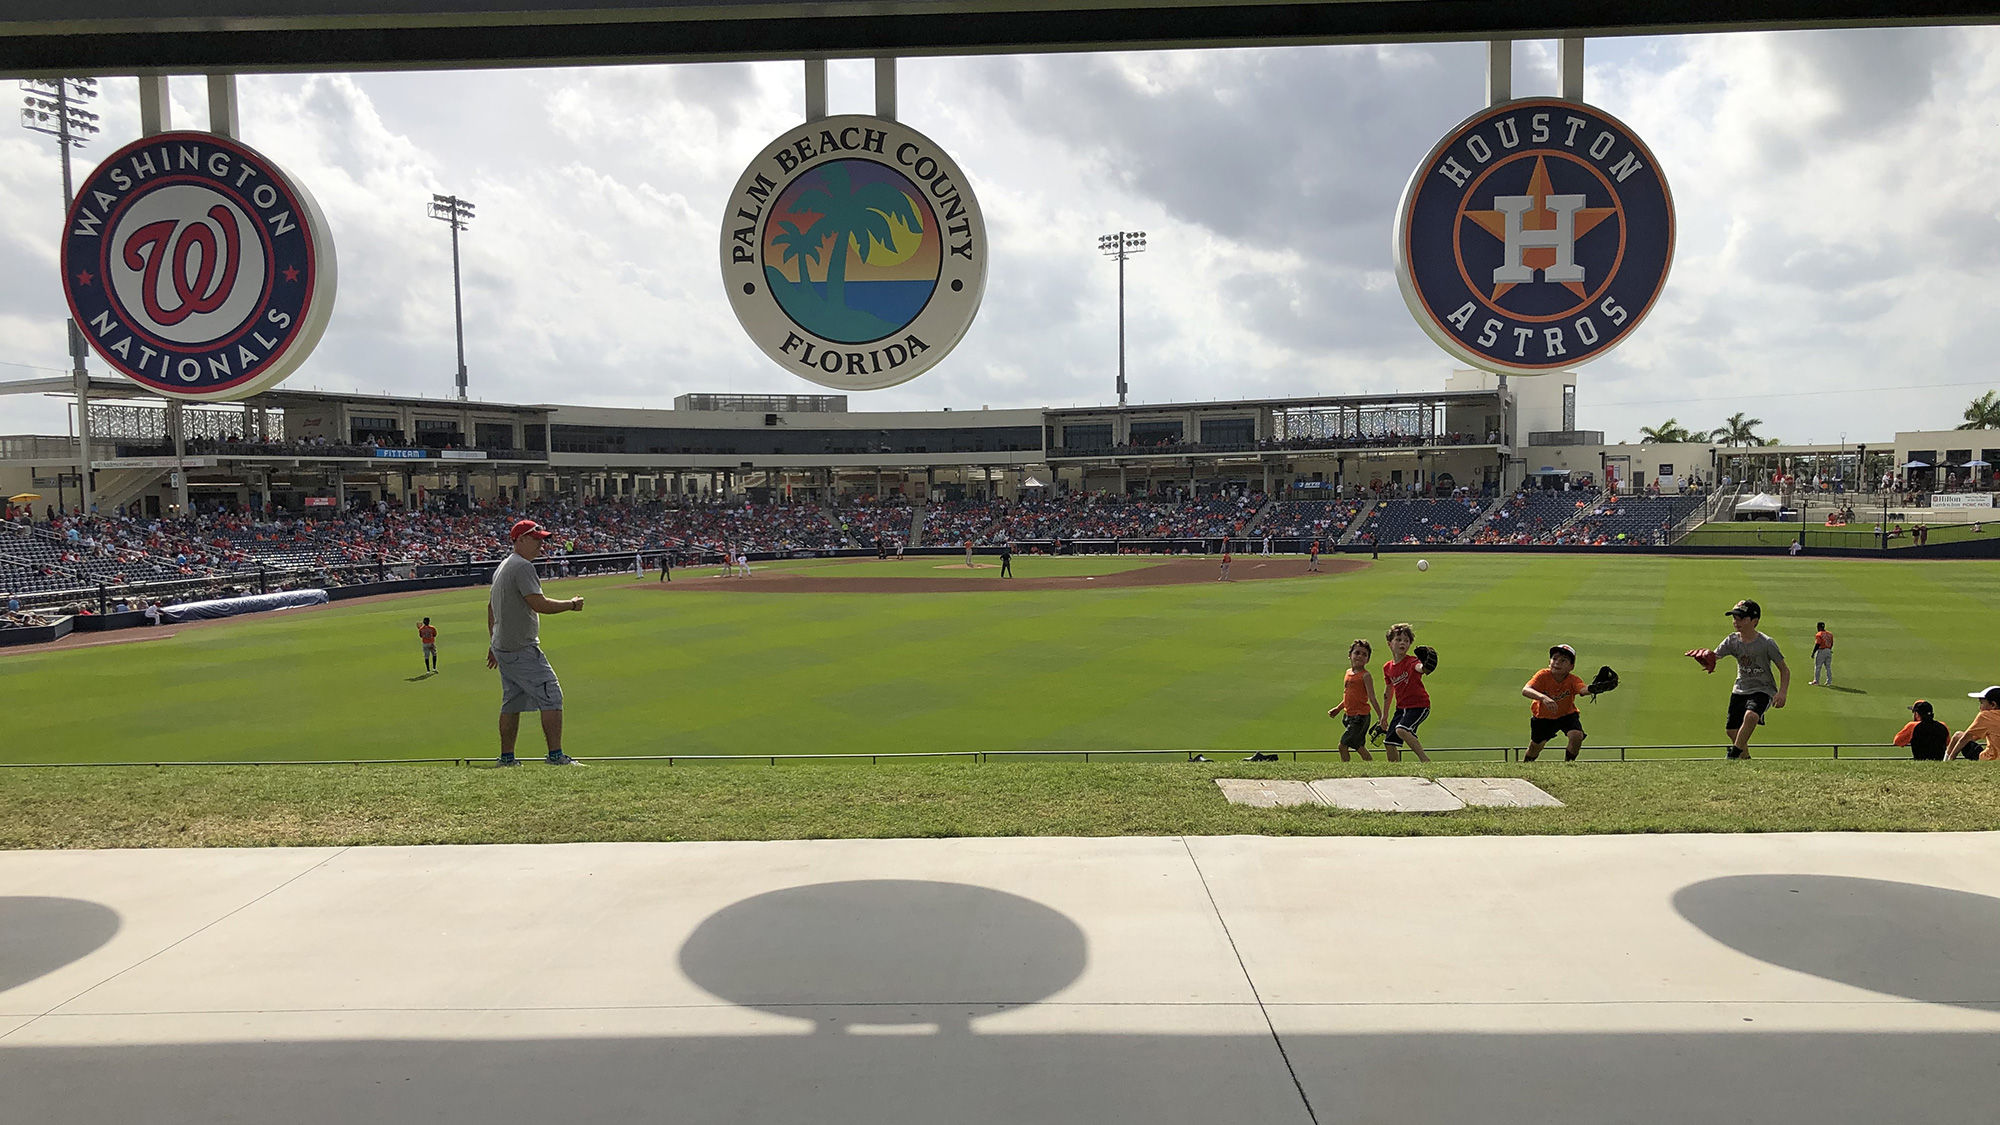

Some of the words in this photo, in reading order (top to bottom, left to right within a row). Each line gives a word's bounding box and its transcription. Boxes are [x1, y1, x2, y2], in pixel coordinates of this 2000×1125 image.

[74, 146, 296, 237] WASHINGTON
[1439, 114, 1643, 188] HOUSTON
[733, 172, 777, 264] PALM
[773, 128, 887, 175] BEACH
[896, 143, 973, 261] COUNTY
[123, 205, 241, 325] W
[1493, 194, 1586, 284] H
[90, 308, 291, 382] NATIONALS
[779, 331, 930, 375] FLORIDA
[1447, 296, 1627, 357] ASTROS
